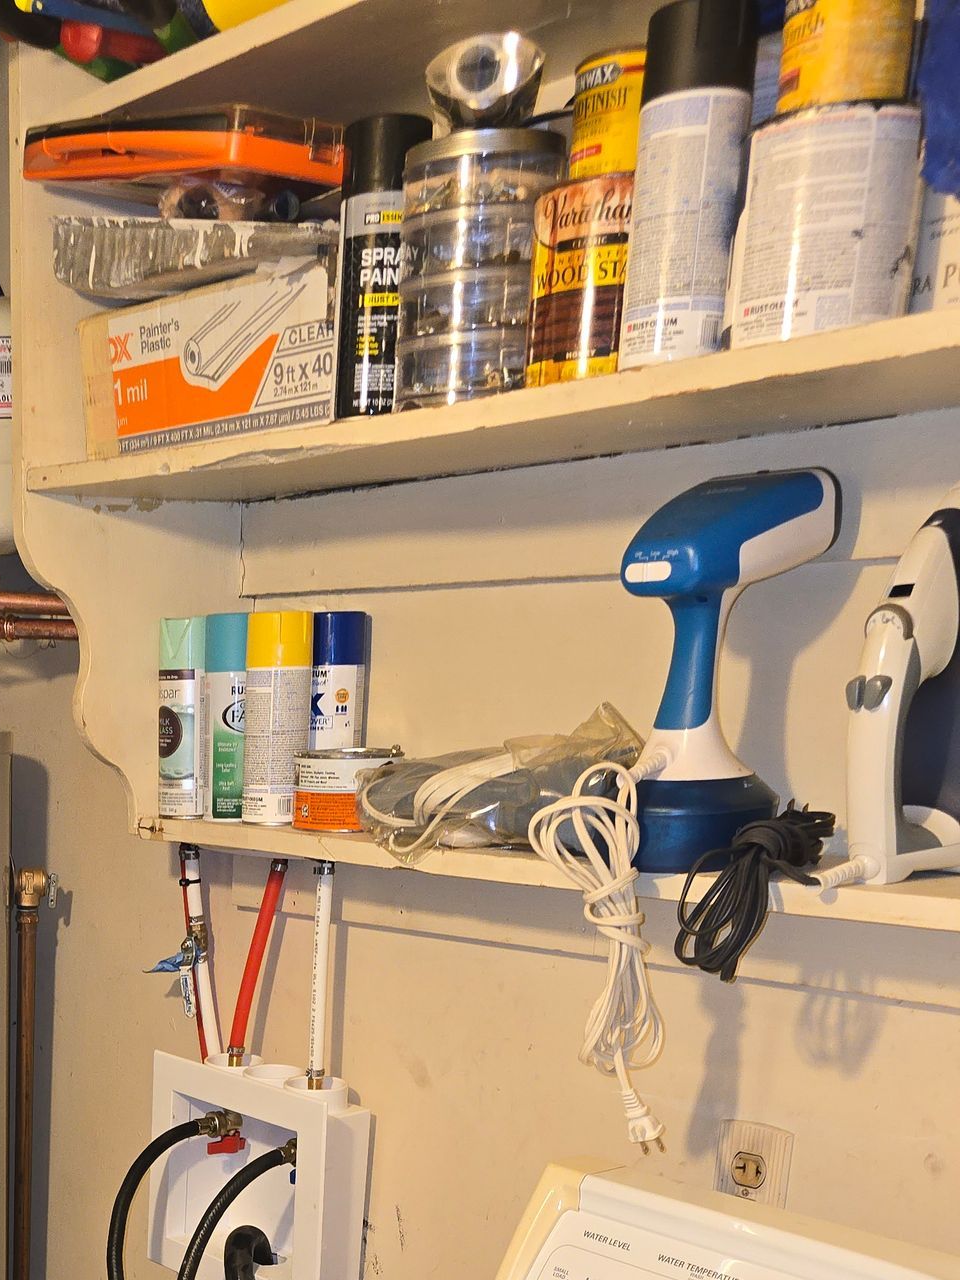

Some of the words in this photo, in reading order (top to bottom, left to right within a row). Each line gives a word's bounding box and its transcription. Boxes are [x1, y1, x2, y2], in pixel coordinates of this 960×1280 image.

[536, 263, 588, 292] WOOD
[140, 318, 180, 340] Painter's
[140, 337, 172, 355] Plastic
[273, 367, 284, 386] 9
[286, 366, 296, 383] ft
[299, 362, 310, 381] X
[127, 379, 148, 402] mil
[583, 1230, 609, 1245] WATER
[608, 1238, 631, 1252] LEVEL
[553, 1266, 569, 1276] SMALL
[657, 1253, 685, 1269] WATER
[552, 1272, 566, 1280] LOAD
